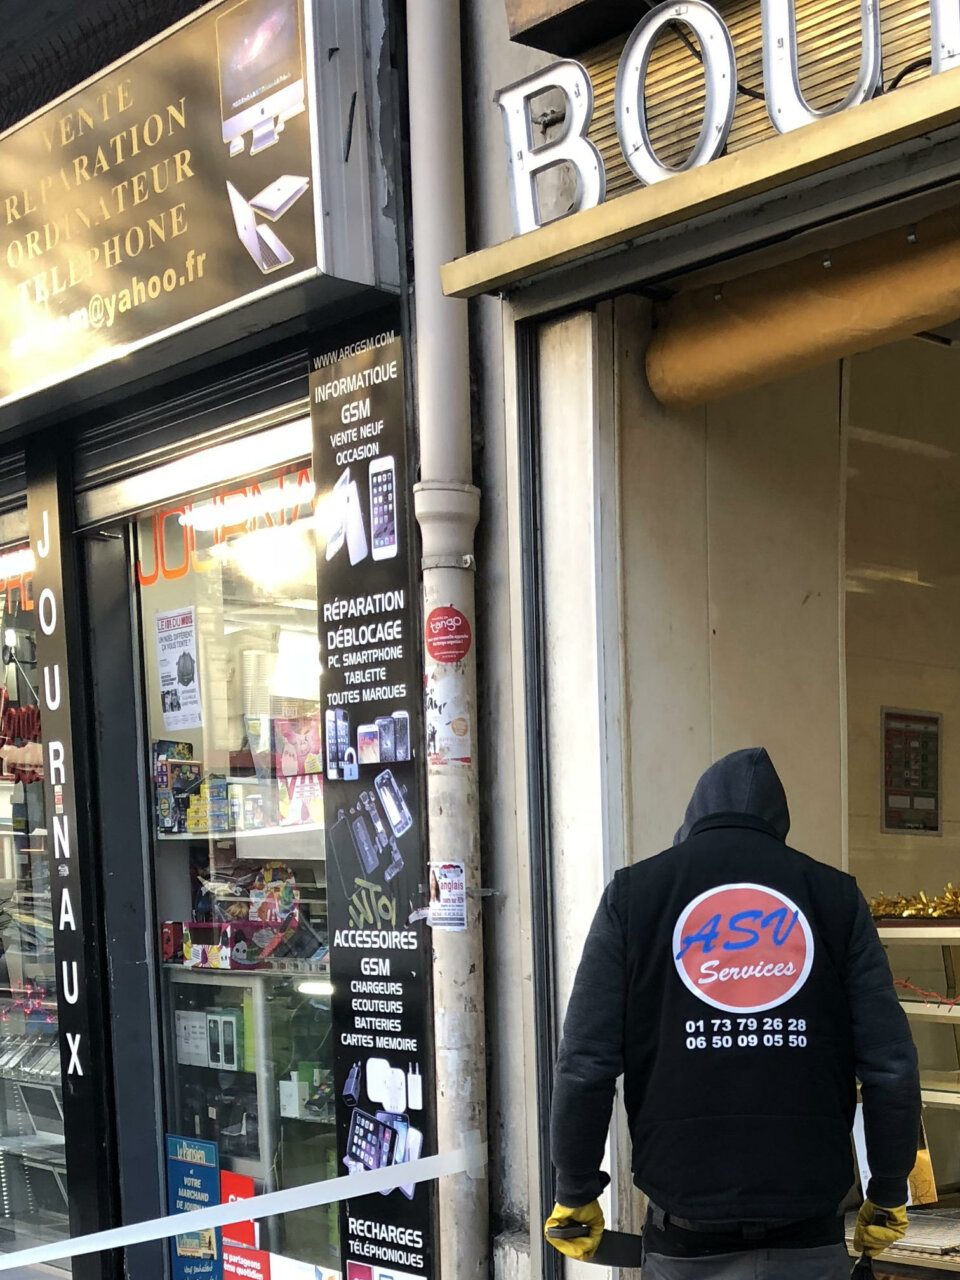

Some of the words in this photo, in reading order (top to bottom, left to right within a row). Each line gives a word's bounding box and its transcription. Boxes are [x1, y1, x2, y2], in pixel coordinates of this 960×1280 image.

[41, 78, 134, 153] VENTE
[313, 330, 395, 370] WWW.ARCGSM.COM
[314, 360, 398, 404] INFORMATIQUE
[341, 398, 371, 424] GSM
[330, 427, 357, 448] VENTE
[360, 420, 384, 439] NEUF
[336, 442, 379, 466] OCCASION
[323, 589, 405, 622] RÉPARATION
[327, 619, 402, 650] DÉBLOCAGE
[430, 616, 462, 634] tango
[328, 655, 341, 669] PC,
[343, 645, 403, 667] SMARTPHONE
[344, 667, 387, 685] TABLETTE
[327, 690, 360, 706] TOUTES
[363, 684, 406, 702] MARQUES
[440, 879, 464, 892] anglais
[334, 930, 417, 950] ACCESSOIRES
[675, 907, 799, 960] ASV
[360, 957, 390, 976] GSM
[698, 960, 797, 985] Services
[350, 980, 403, 995] CHARGEURS
[352, 998, 403, 1014] ECOUTEURS
[354, 1016, 401, 1032] BATTERIES
[685, 1020, 704, 1033] 01
[711, 1019, 732, 1032] 73
[736, 1018, 758, 1031] 79
[762, 1018, 783, 1031] 26
[787, 1018, 807, 1032] 28
[341, 1033, 374, 1048] CARTES
[376, 1036, 417, 1052] MEMOIRE
[686, 1036, 707, 1050] 06
[711, 1035, 732, 1048] 50
[737, 1034, 758, 1047] 09
[763, 1034, 784, 1047] 05
[788, 1034, 808, 1048] 50
[183, 1176, 202, 1189] VOTRE
[176, 1199, 183, 1210] DE
[178, 1187, 209, 1202] MARCHAND
[348, 1217, 423, 1248] RECHARGES
[229, 1254, 261, 1269] partageons
[348, 1239, 424, 1268] TÉLÉPHONIQUES
